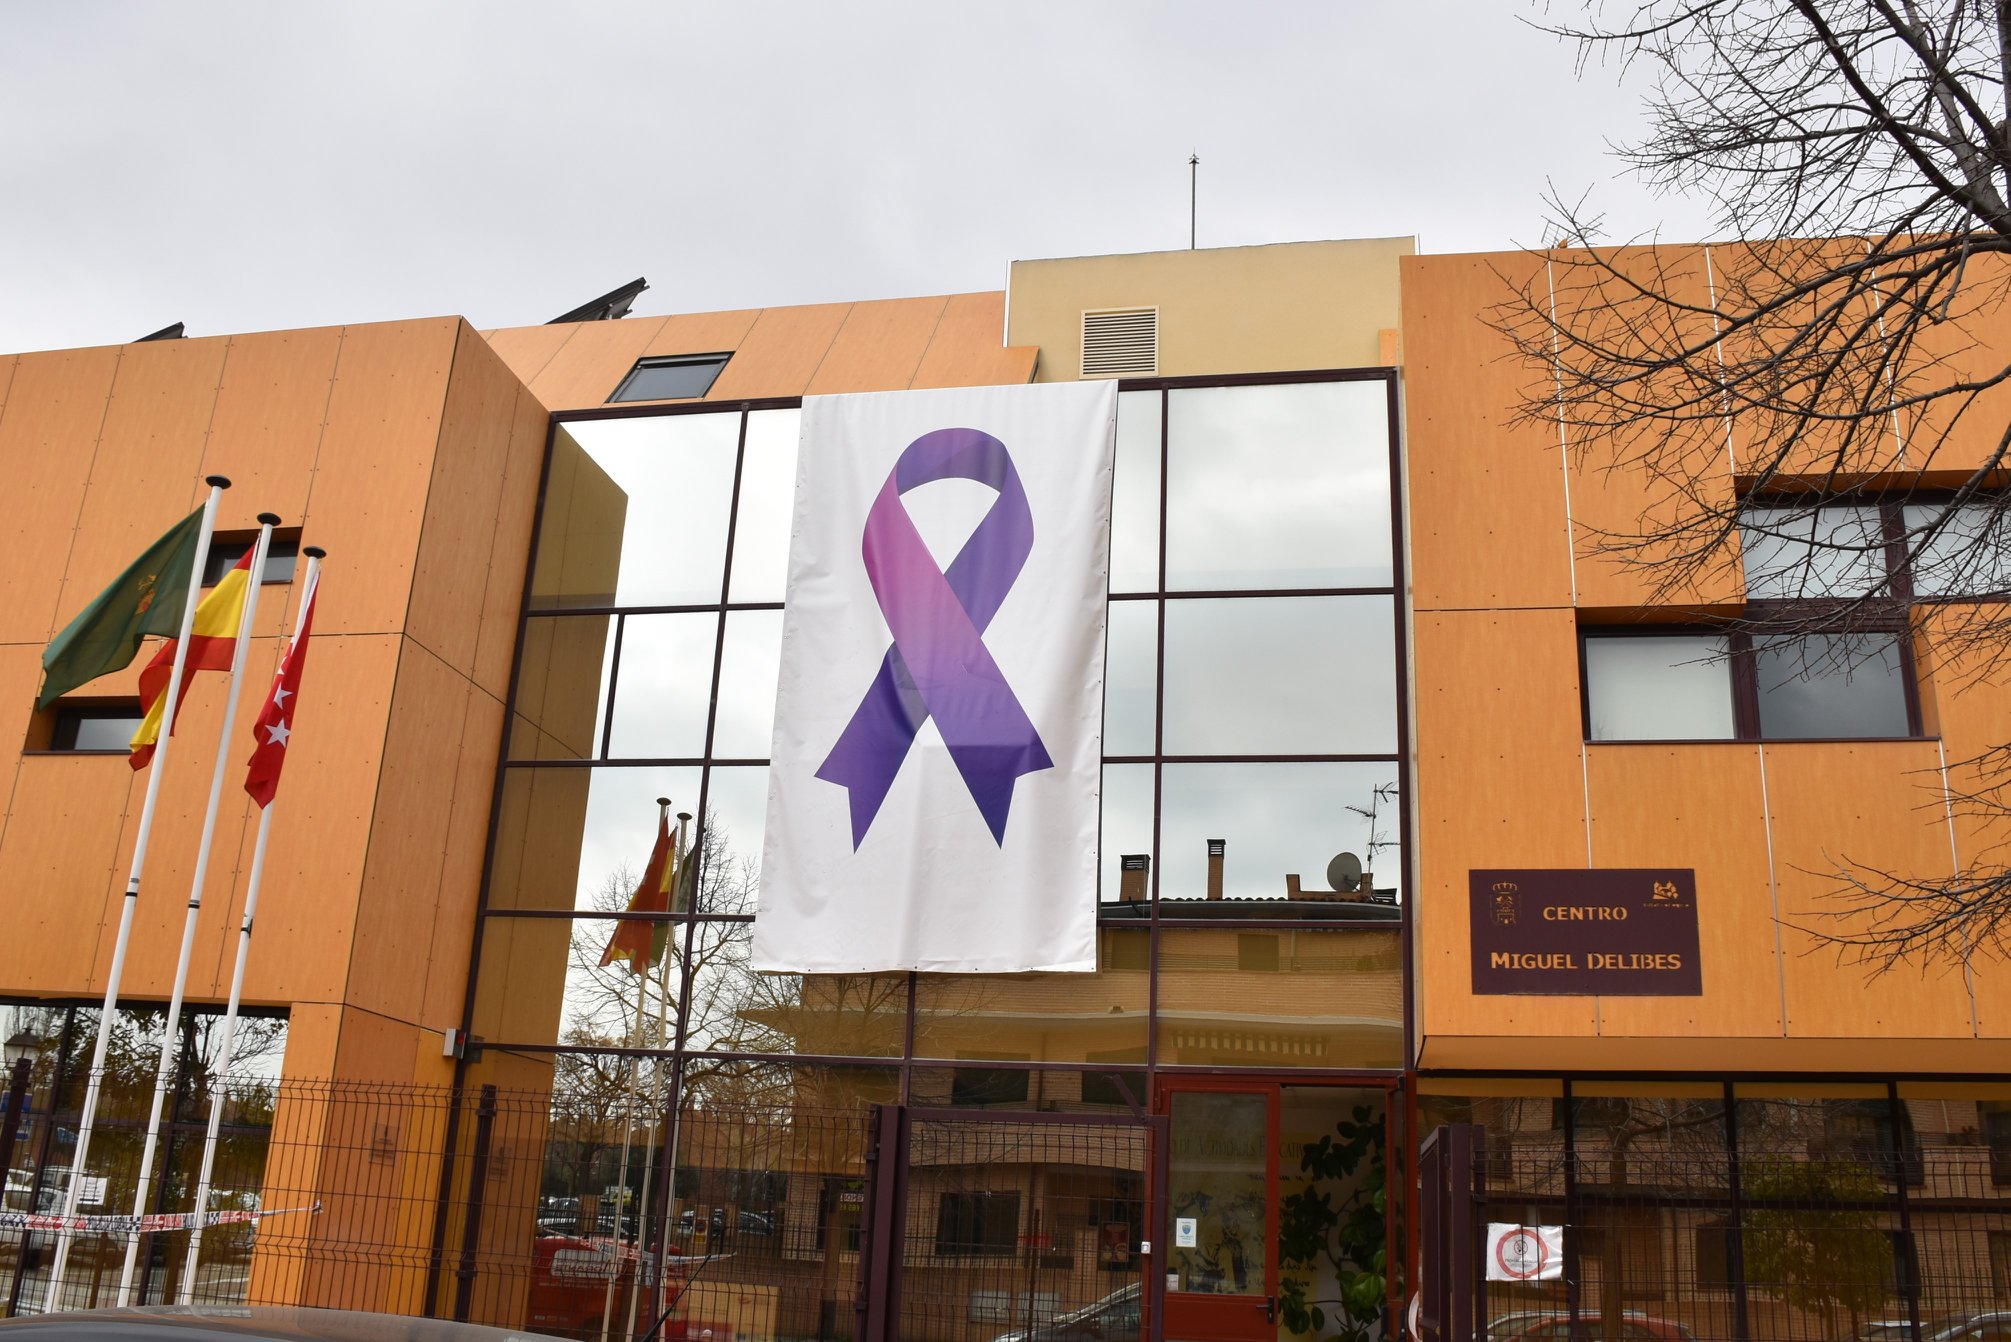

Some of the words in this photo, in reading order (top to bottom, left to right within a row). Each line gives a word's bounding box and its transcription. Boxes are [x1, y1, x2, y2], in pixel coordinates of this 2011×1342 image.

[1543, 906, 1628, 921] CENTRO
[1491, 952, 1578, 969] MIGUEL
[1587, 953, 1682, 970] DELIBES
